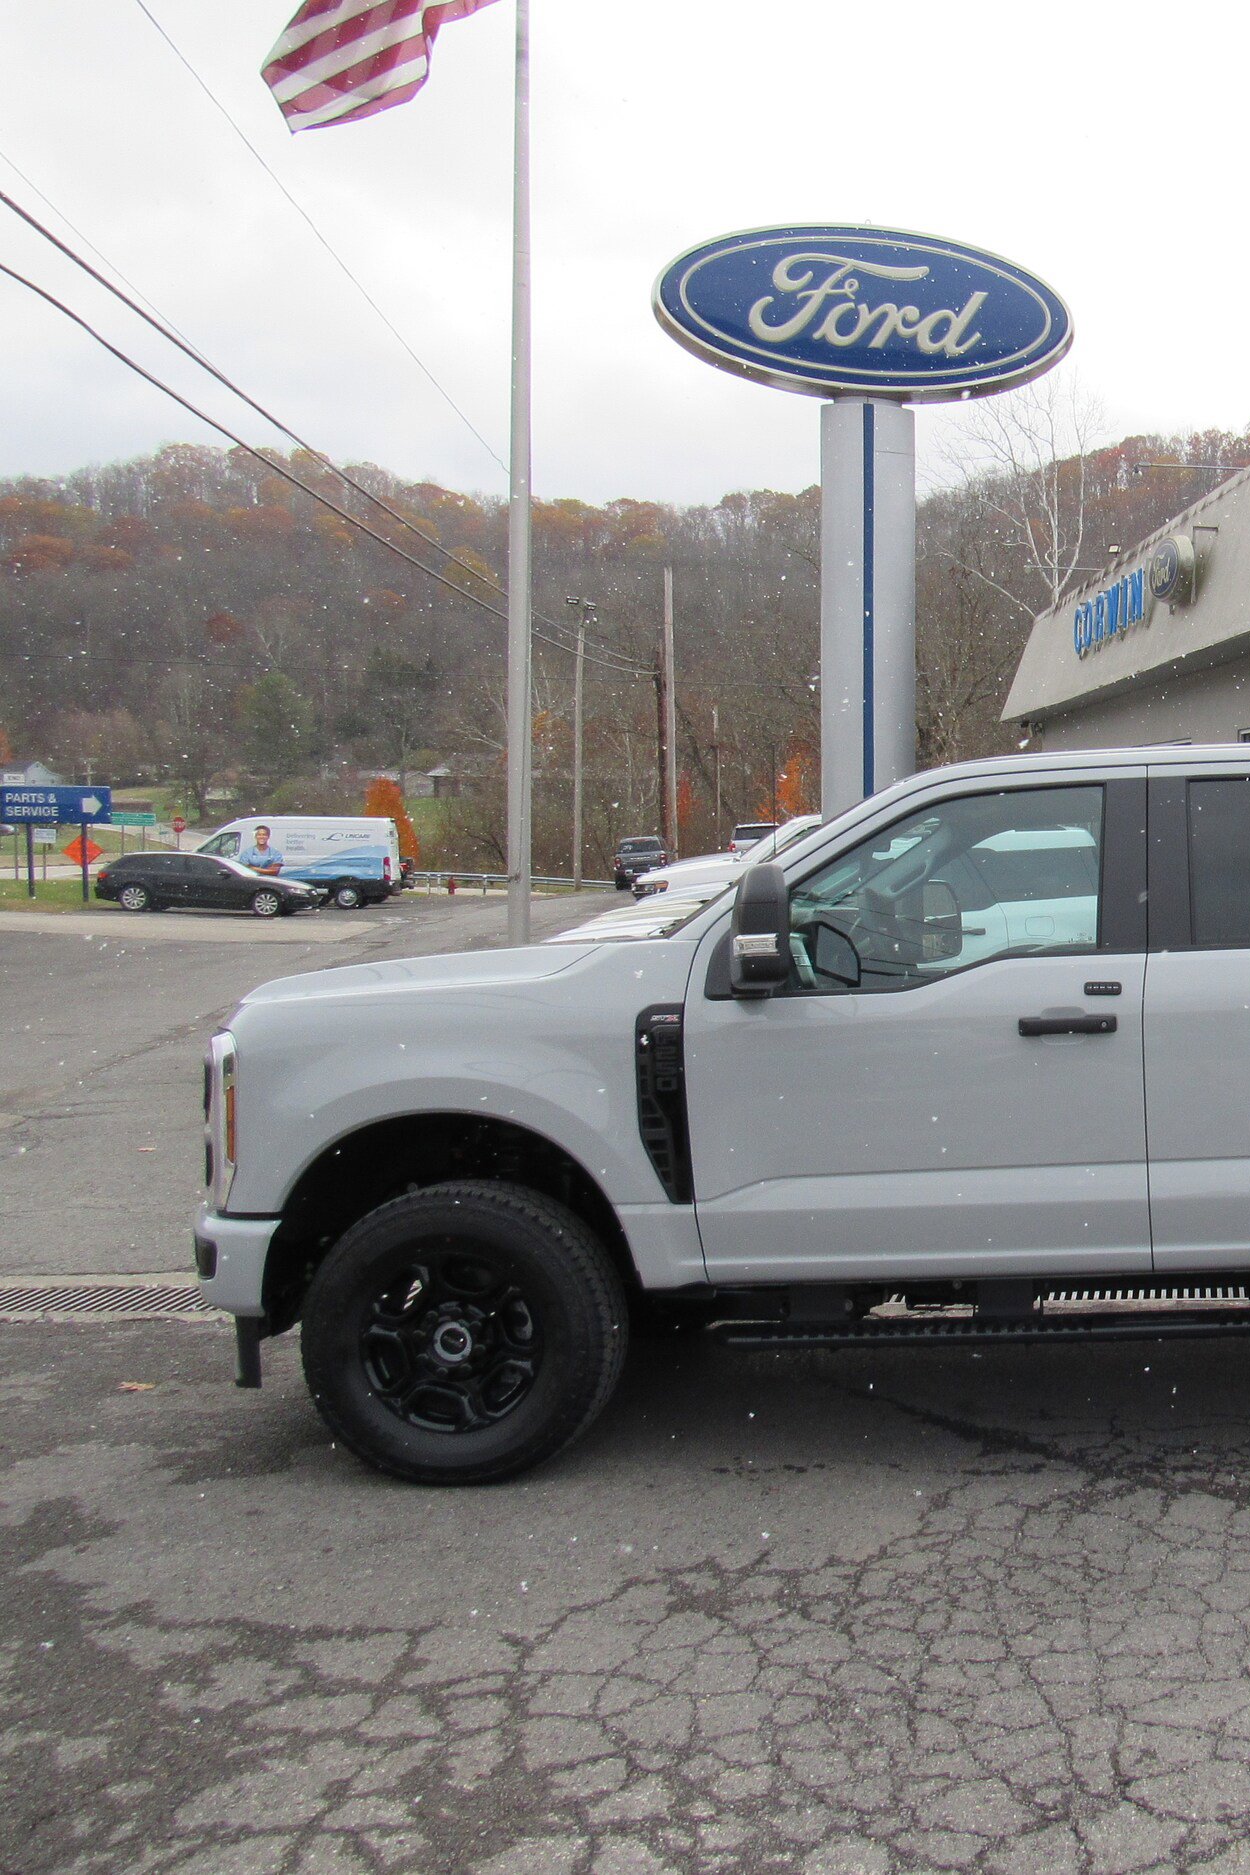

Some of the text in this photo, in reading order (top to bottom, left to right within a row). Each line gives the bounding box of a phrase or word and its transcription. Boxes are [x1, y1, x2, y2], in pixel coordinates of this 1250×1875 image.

[749, 252, 989, 357] Ford
[1153, 552, 1171, 588] Ford
[5, 793, 57, 803] PARTS &
[5, 806, 59, 816] SERVICE
